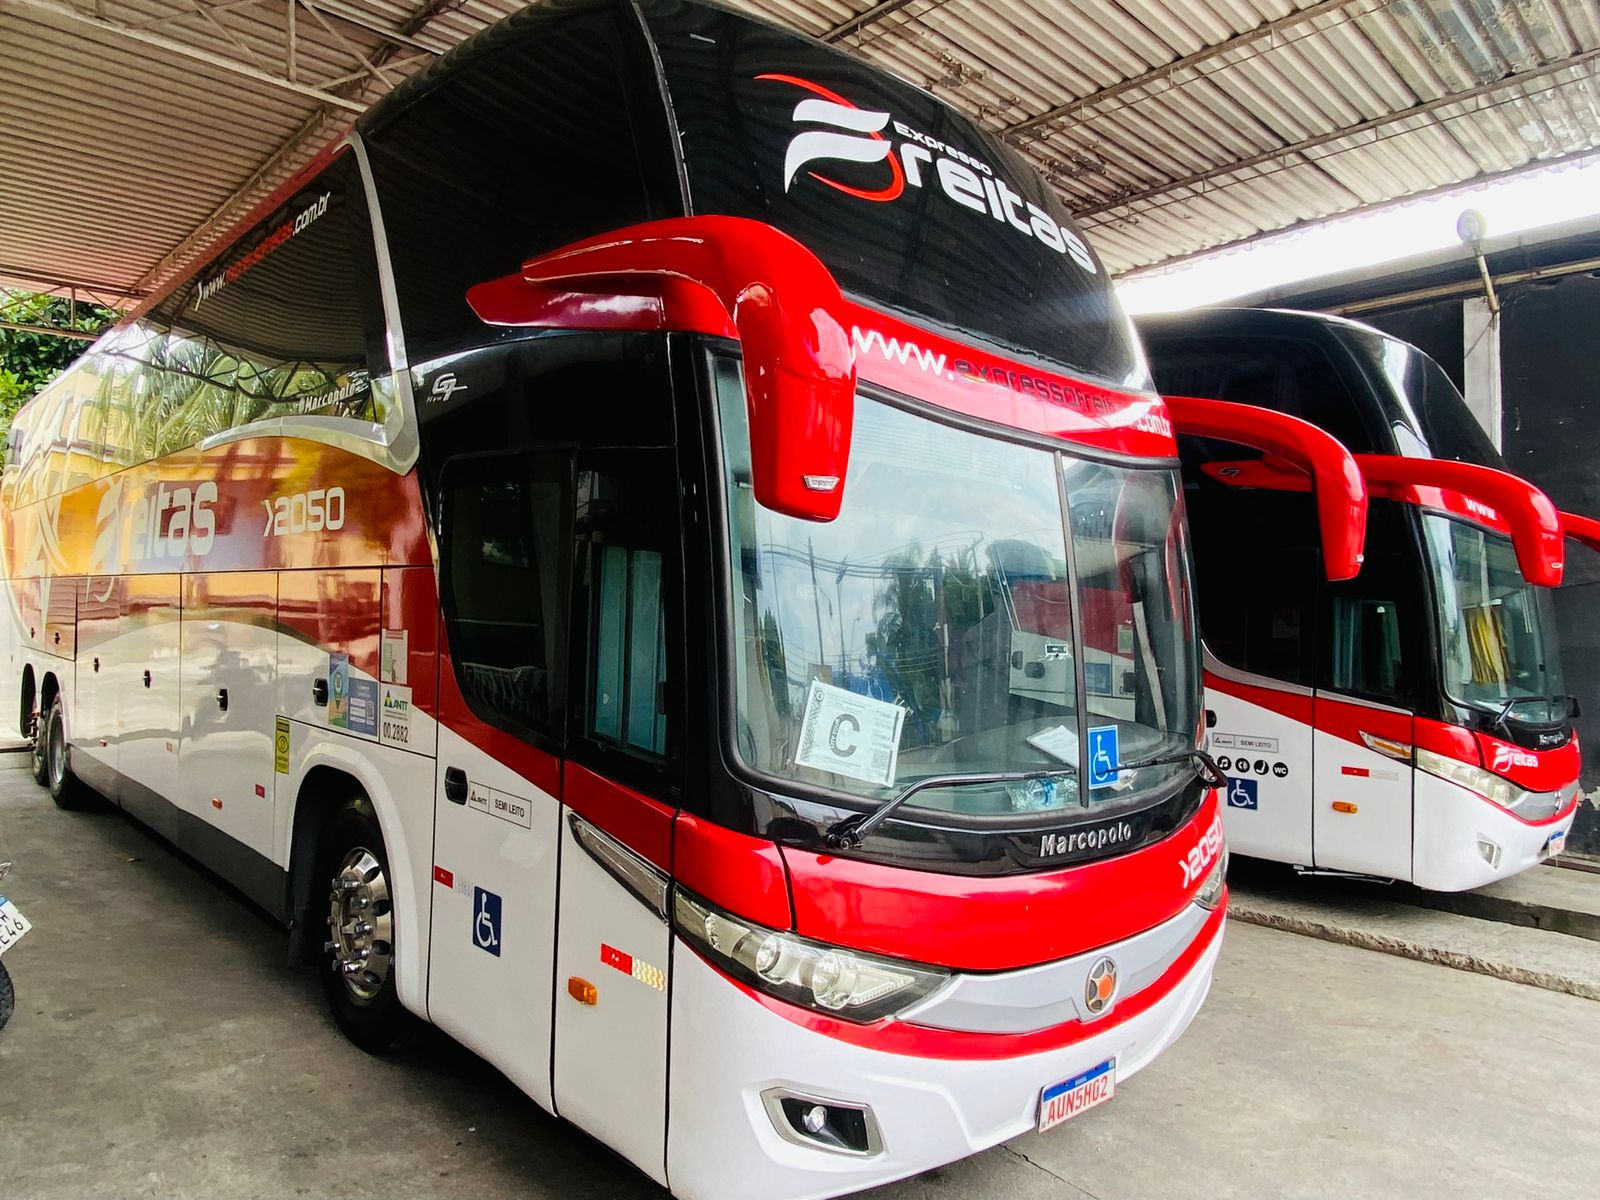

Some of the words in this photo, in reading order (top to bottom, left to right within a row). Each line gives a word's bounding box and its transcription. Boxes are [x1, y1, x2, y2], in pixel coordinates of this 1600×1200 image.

[893, 121, 993, 176] Expresso
[829, 713, 860, 758] C
[1255, 741, 1272, 749] LEITO
[494, 798, 508, 812] SEMI
[508, 803, 525, 818] LEITO
[1040, 822, 1132, 858] Marcopolo
